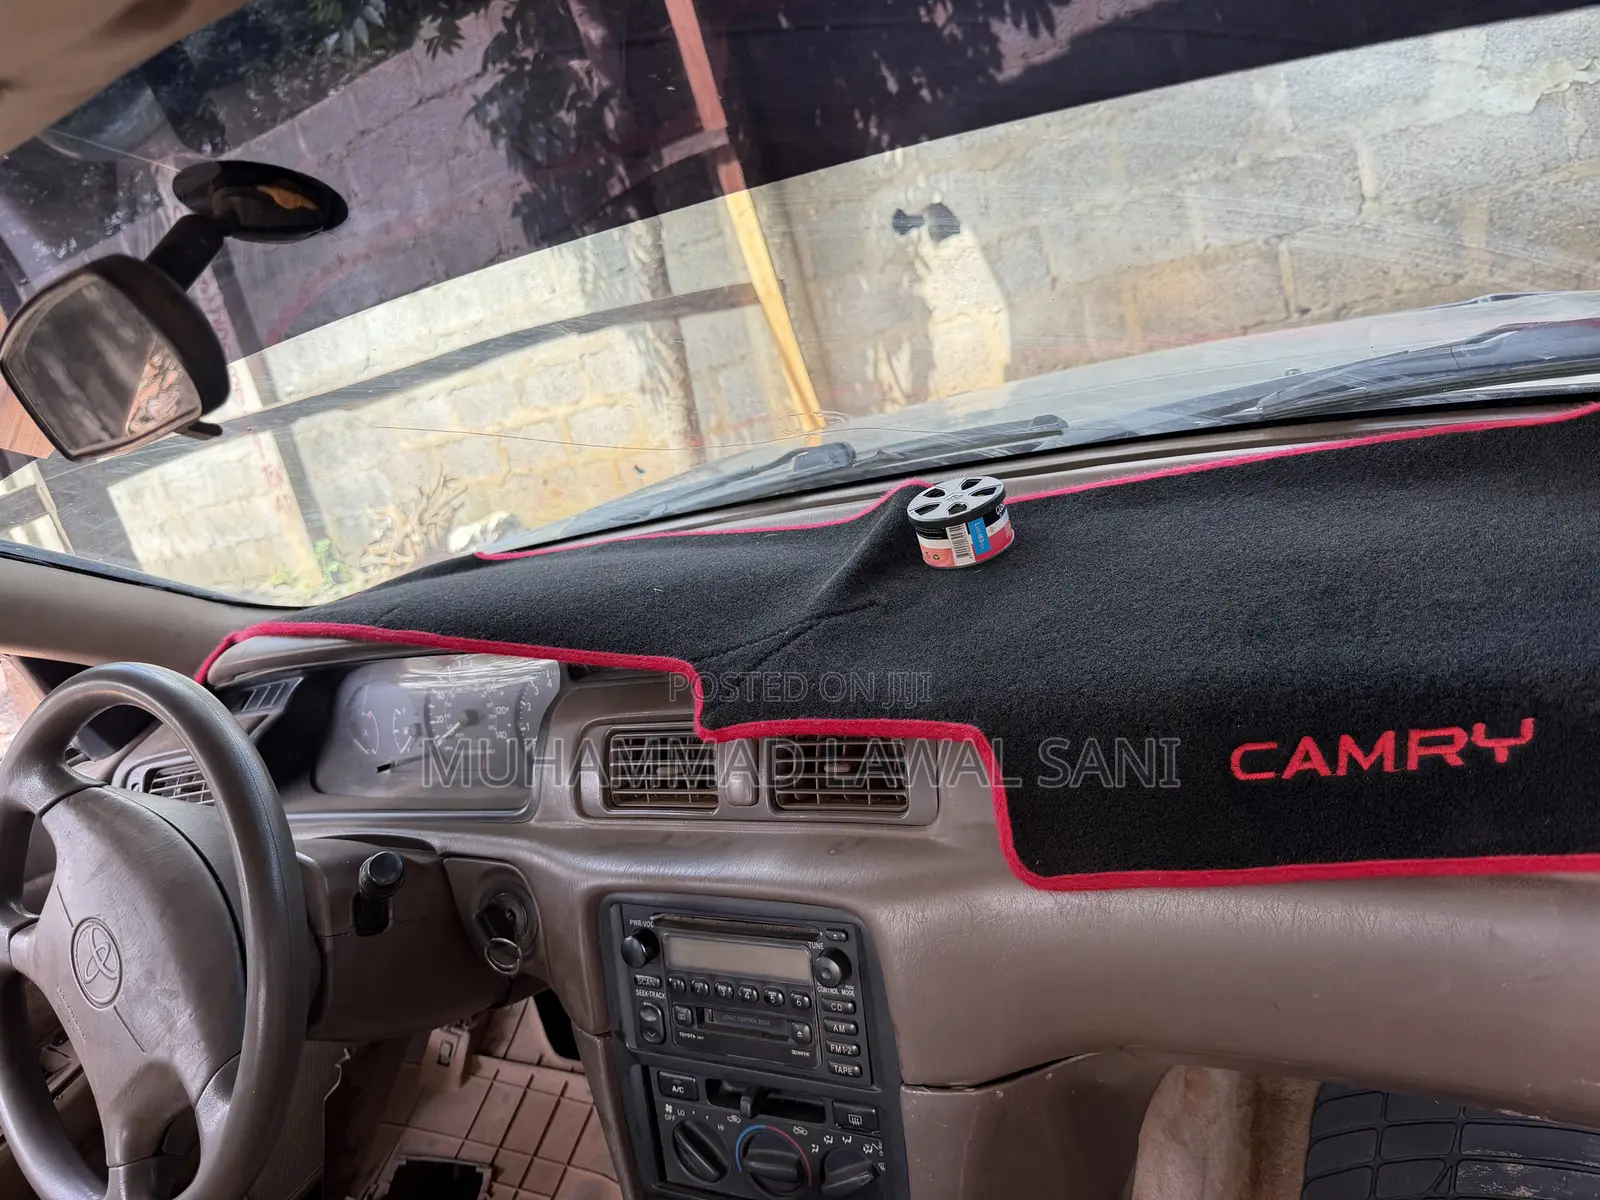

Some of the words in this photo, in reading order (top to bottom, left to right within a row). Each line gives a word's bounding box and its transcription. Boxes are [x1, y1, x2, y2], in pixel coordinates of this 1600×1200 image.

[496, 707, 506, 715] 120
[436, 715, 444, 723] 20
[496, 731, 507, 739] 140
[1230, 717, 1535, 781] CAMRY
[808, 941, 824, 950] TUNE
[817, 985, 839, 995] CONTROL
[841, 989, 855, 997] MODE
[796, 998, 802, 1007] 6
[831, 1002, 843, 1011] CD
[833, 1024, 846, 1033] AM
[834, 1064, 853, 1076] TAPE
[672, 1085, 684, 1093] A/C
